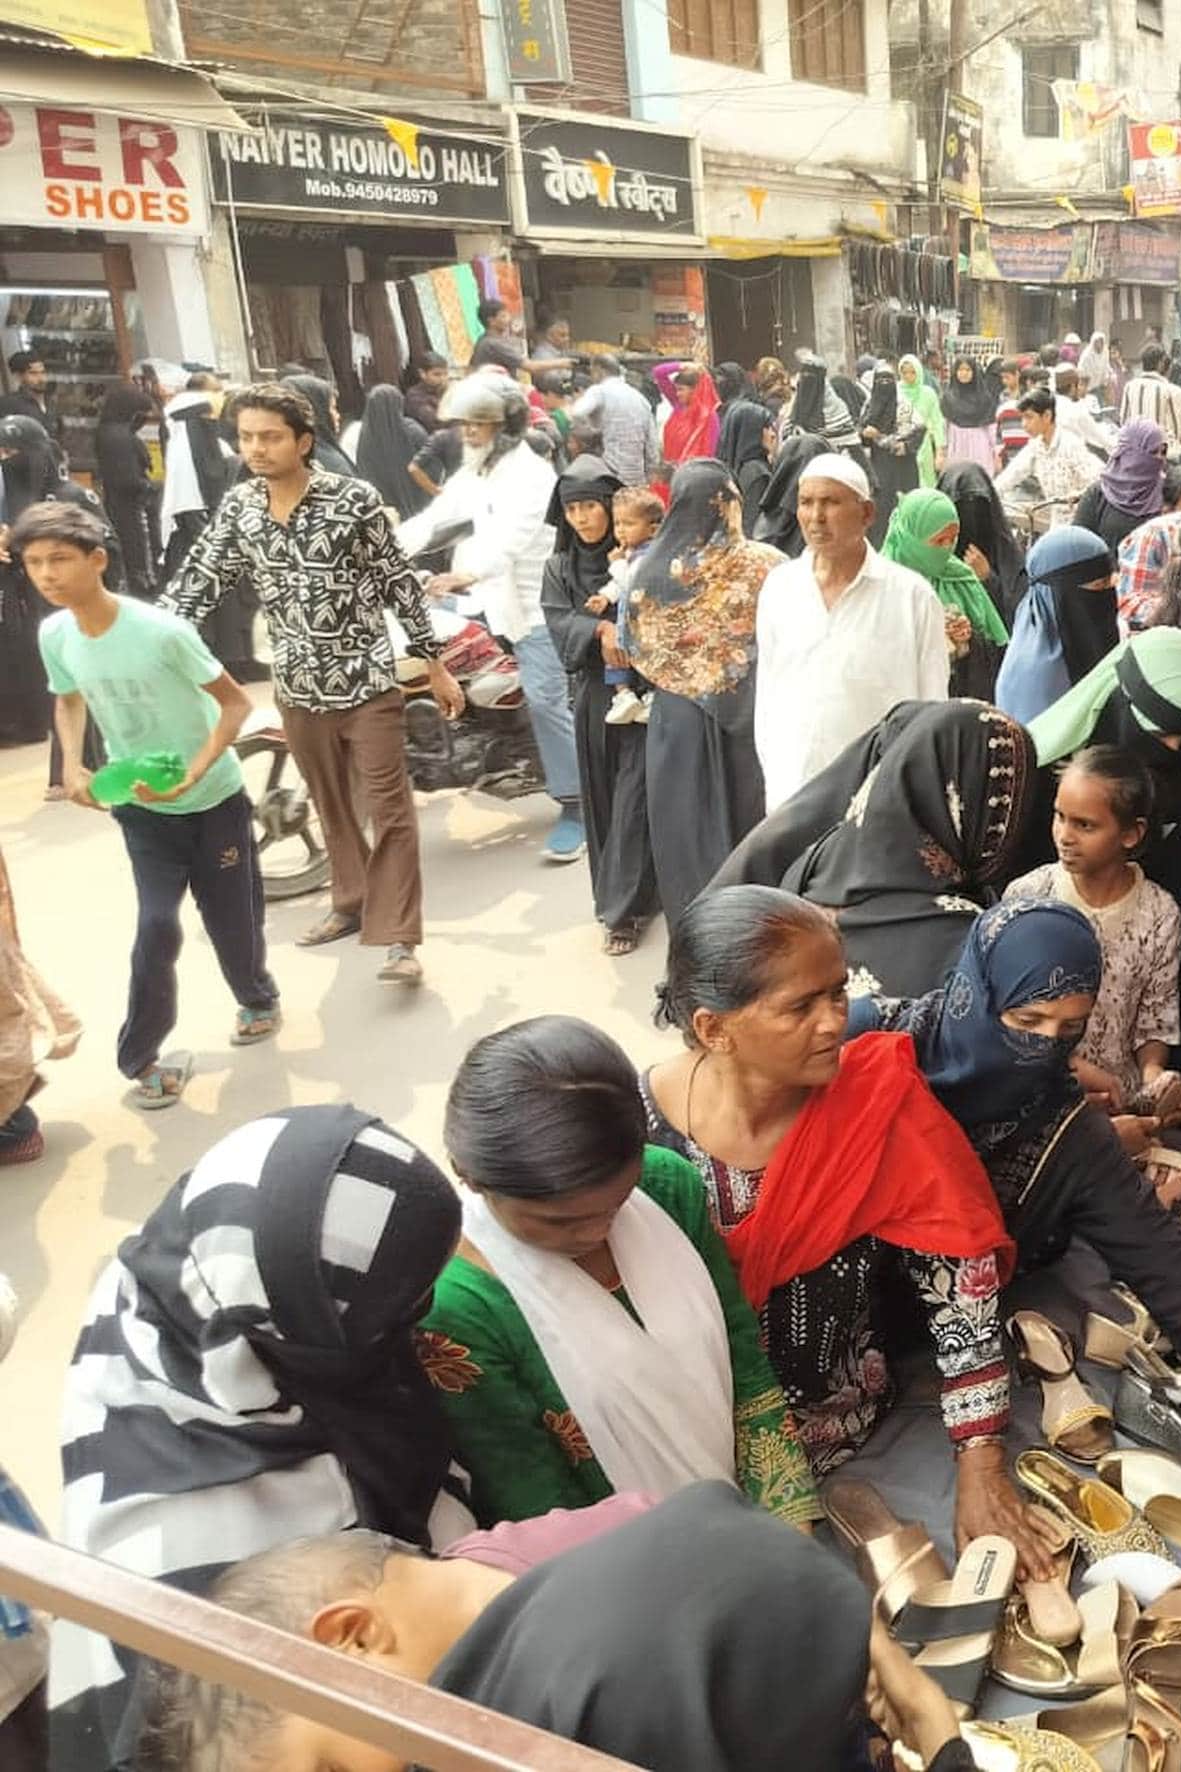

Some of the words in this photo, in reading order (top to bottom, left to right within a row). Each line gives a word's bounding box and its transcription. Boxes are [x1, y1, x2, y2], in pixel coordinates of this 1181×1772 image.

[0, 105, 187, 189] ER
[218, 128, 325, 169] NAIYER
[441, 148, 499, 187] HALL
[45, 184, 191, 225] SHOES
[305, 178, 439, 206] Mob.9450428979
